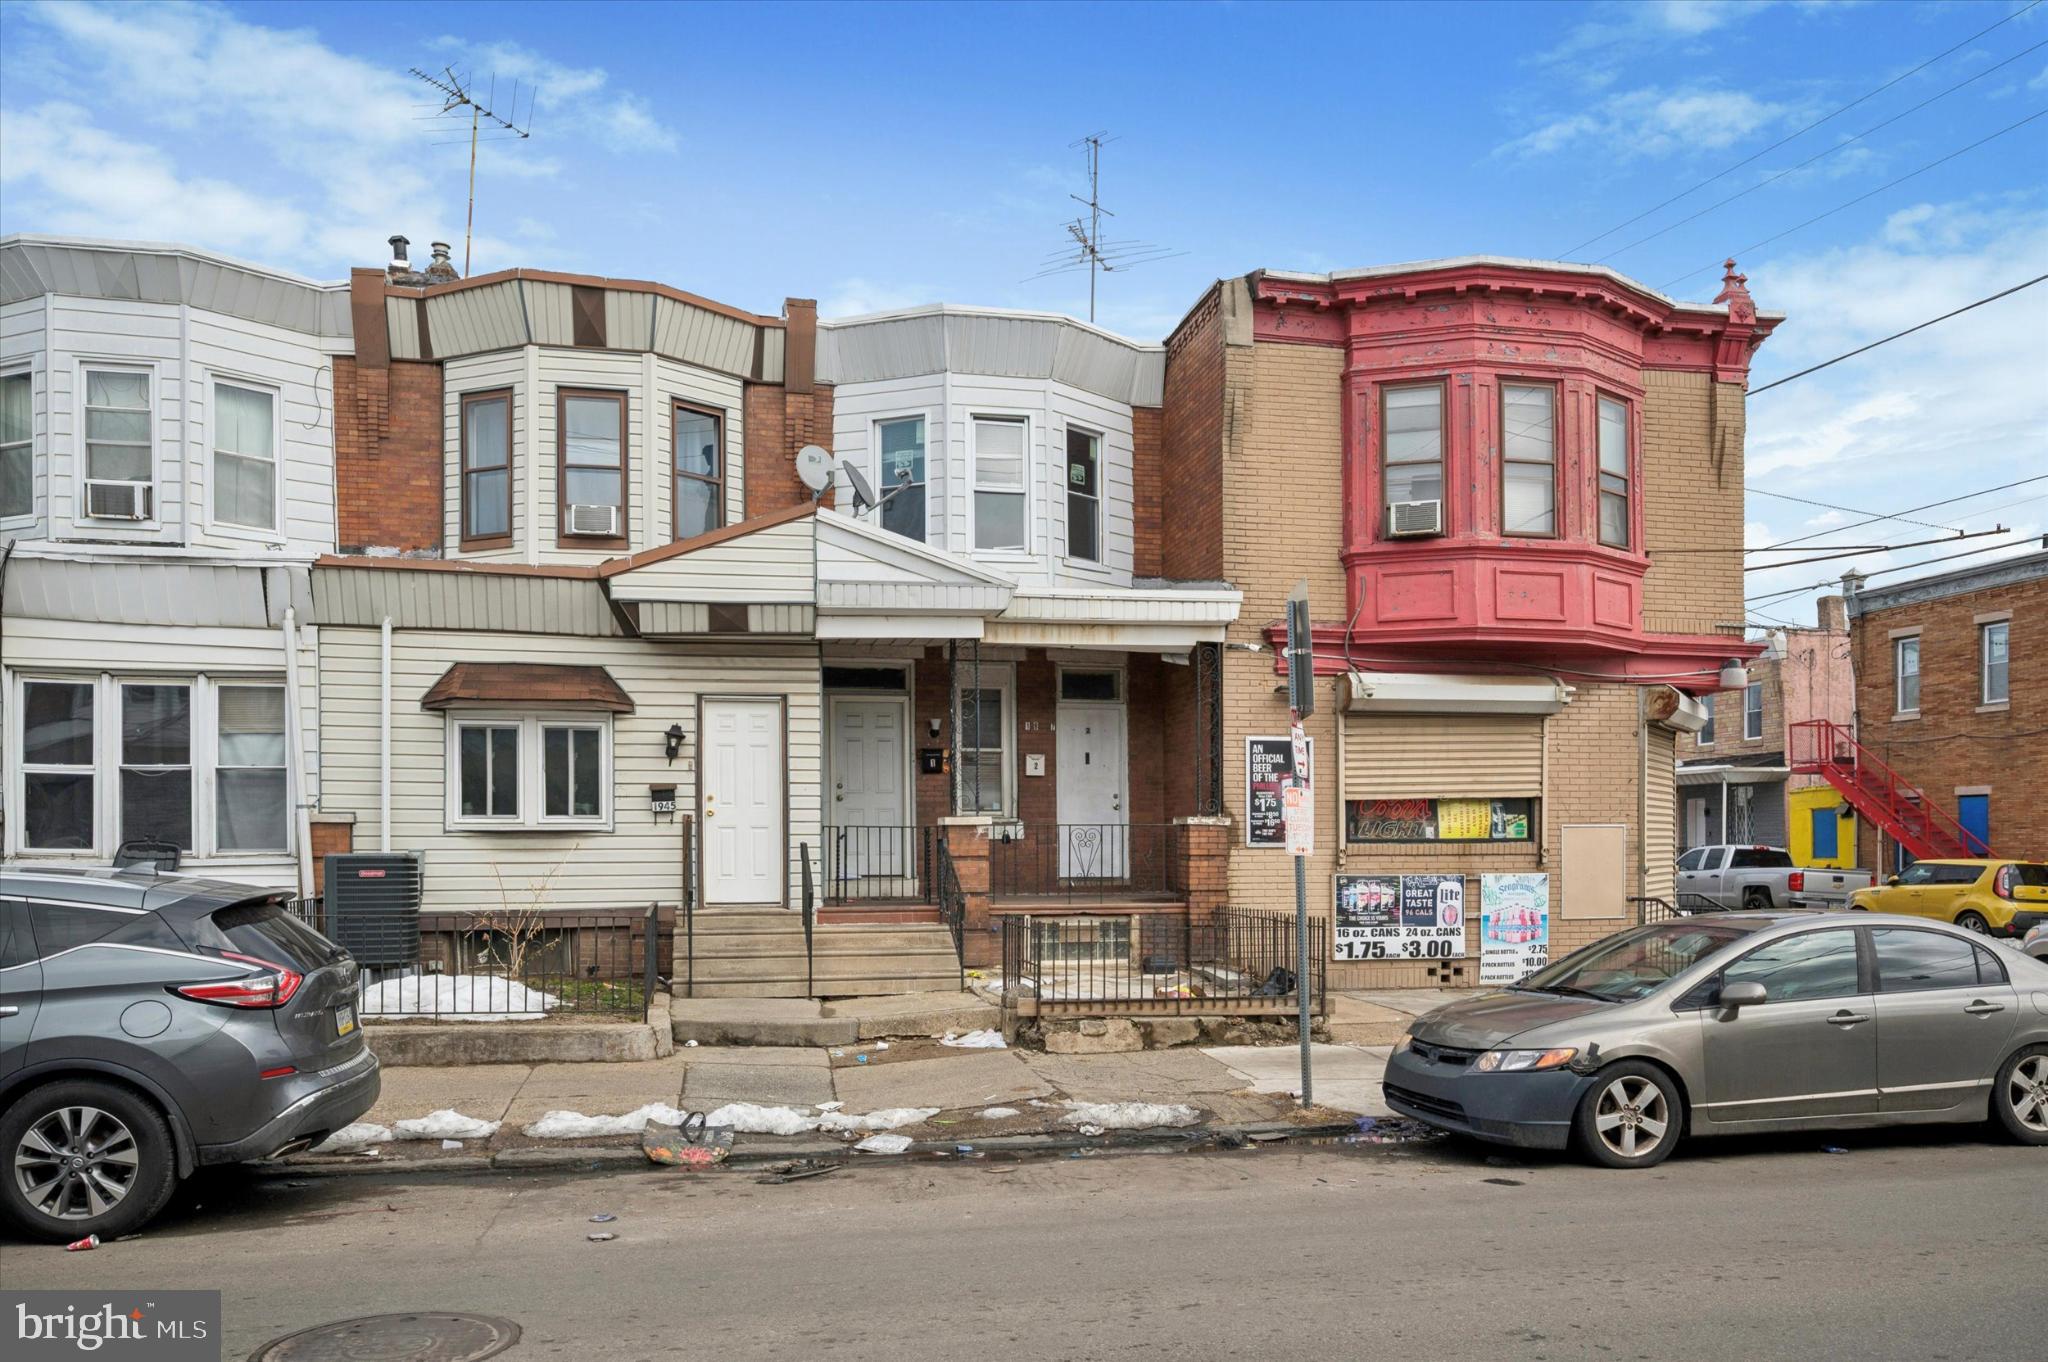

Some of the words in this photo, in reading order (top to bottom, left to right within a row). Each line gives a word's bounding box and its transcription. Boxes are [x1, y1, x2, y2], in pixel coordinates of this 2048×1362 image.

[1252, 744, 1263, 754] AN
[1252, 754, 1285, 763] OFFICIAL
[1252, 763, 1272, 773] BEER
[1252, 772, 1263, 783] OF
[1264, 772, 1279, 783] THE
[1357, 820, 1427, 839] LIGHT
[1405, 889, 1434, 898] GREAT
[1440, 888, 1460, 904] Lite
[1405, 898, 1433, 907] TASTE
[1405, 908, 1414, 916] 96
[1415, 908, 1433, 916] CALS
[1336, 928, 1349, 938] 16
[1352, 929, 1368, 938] oz.
[1370, 928, 1400, 937] CANS
[1405, 927, 1418, 937] 24
[1420, 928, 1434, 937] oz.
[1436, 927, 1461, 937] CANS
[1335, 941, 1386, 959] $1.75
[1402, 940, 1453, 958] $3.00
[1528, 944, 1548, 955] $2.75
[1522, 957, 1547, 967] $10.00
